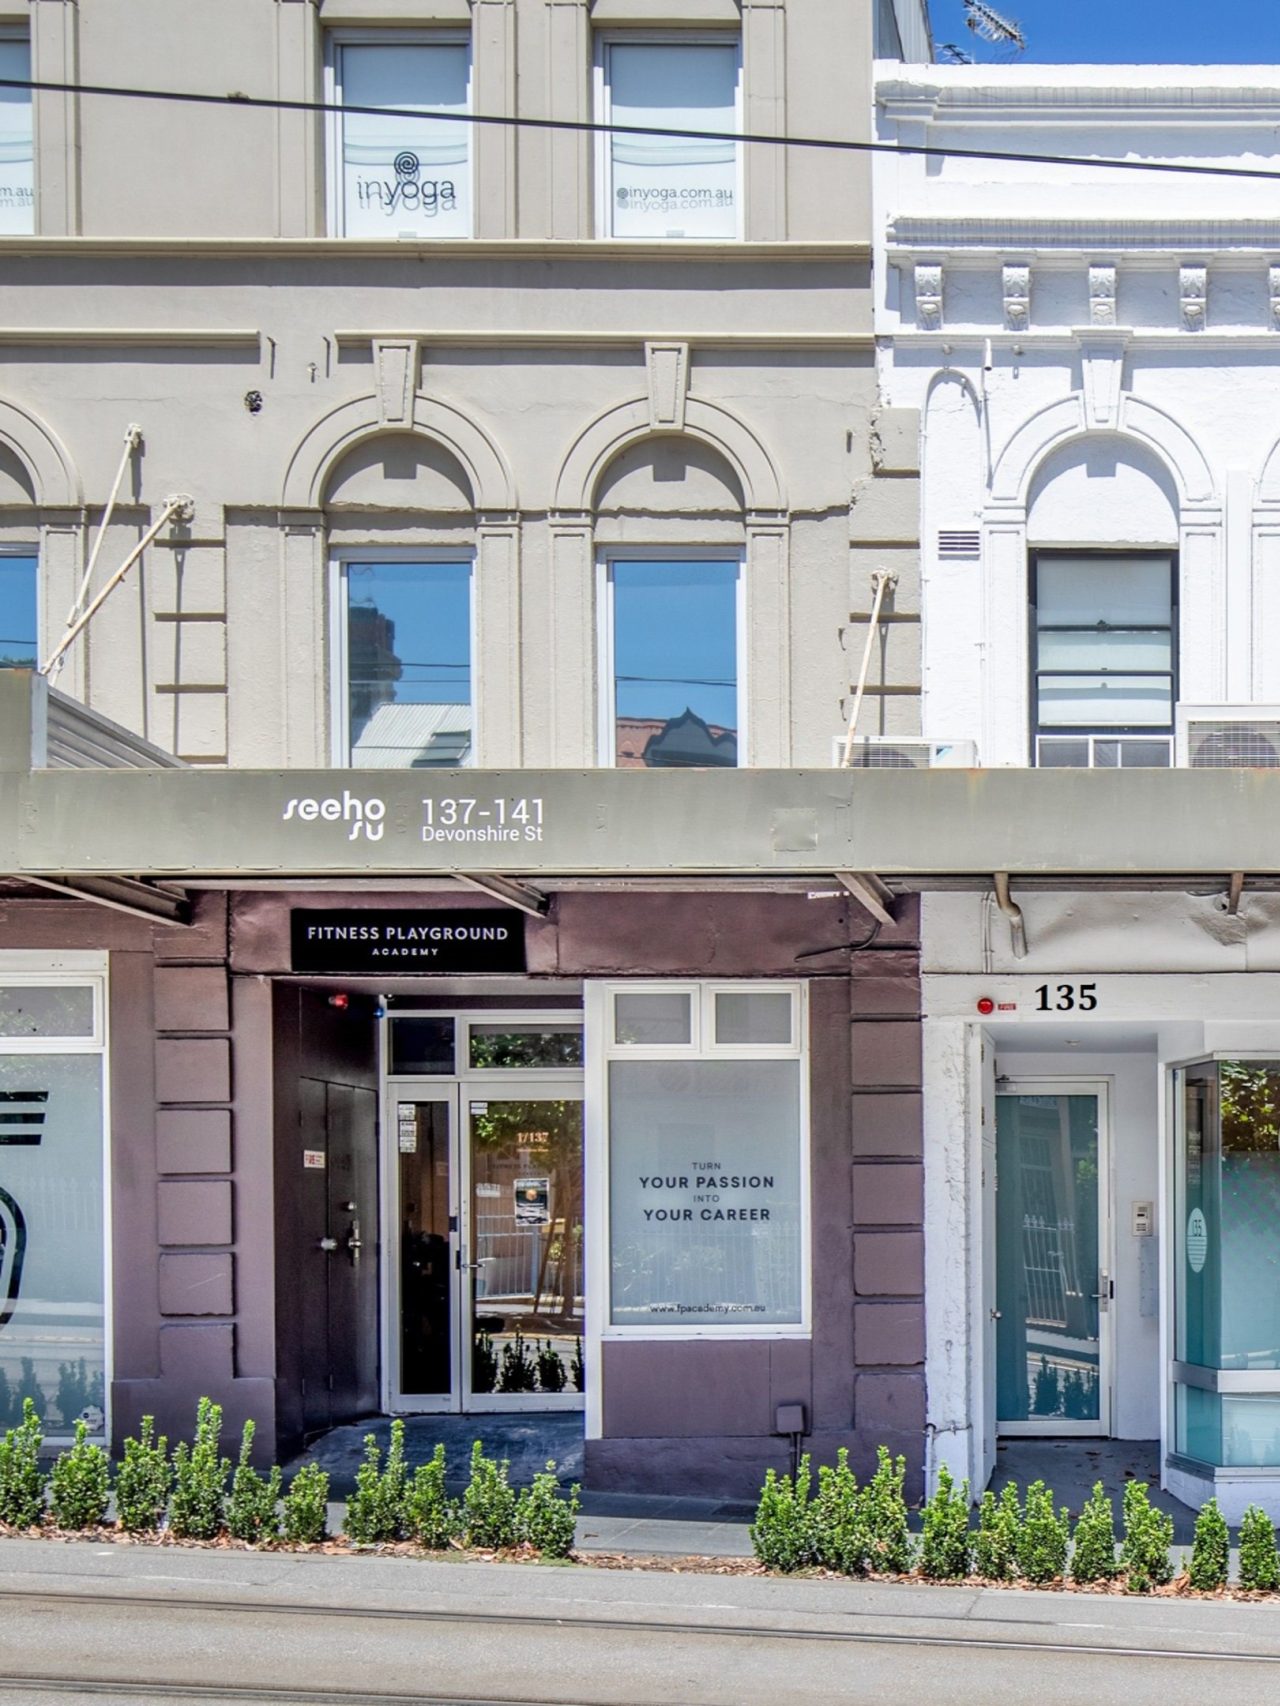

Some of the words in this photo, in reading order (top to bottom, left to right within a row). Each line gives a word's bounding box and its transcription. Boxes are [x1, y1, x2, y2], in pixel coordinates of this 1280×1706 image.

[357, 175, 456, 206] inyoga
[629, 186, 733, 201] inyoga.com.au
[421, 798, 544, 825] 137-141
[422, 826, 520, 842] Devonshire
[524, 826, 543, 842] St
[307, 926, 380, 940] FITNESS
[386, 926, 508, 940] PLAYGROUND
[372, 948, 439, 956] ACADEMY
[1035, 983, 1098, 1011] 135
[692, 1162, 721, 1170] TURN
[639, 1177, 689, 1189] YOUR
[695, 1176, 775, 1188] PASSION
[693, 1194, 720, 1203] INTO
[643, 1209, 693, 1221] YOUR
[700, 1208, 771, 1220] CAREER
